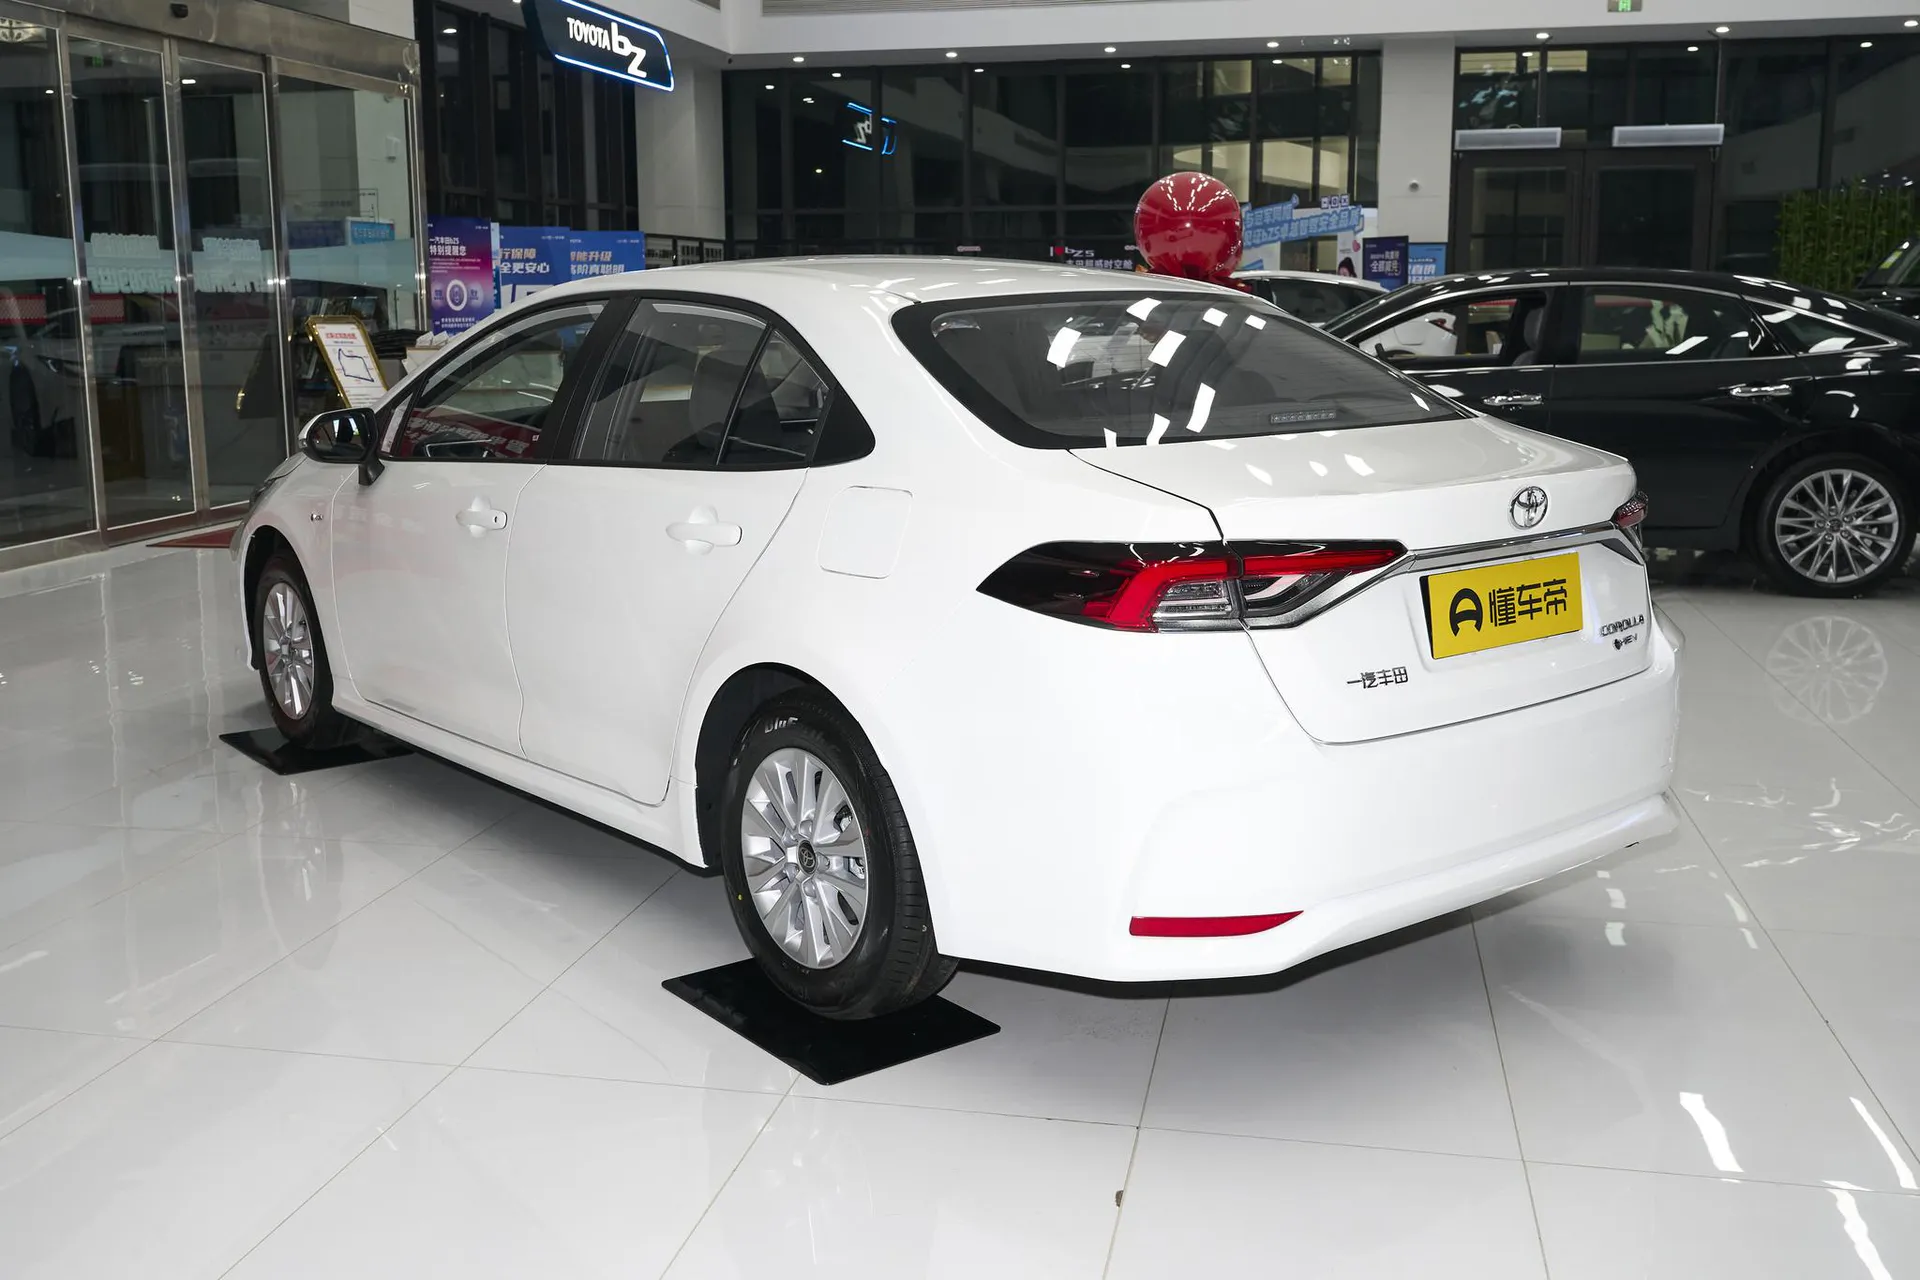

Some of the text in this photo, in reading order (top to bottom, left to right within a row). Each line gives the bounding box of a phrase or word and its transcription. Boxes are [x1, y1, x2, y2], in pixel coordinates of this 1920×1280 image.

[566, 16, 611, 51] TOYOTA
[429, 245, 467, 257] 特别提醒您
[1488, 578, 1568, 627] 懂车帝
[1600, 613, 1645, 637] COROLLA
[1346, 666, 1409, 689] 一汽丰田
